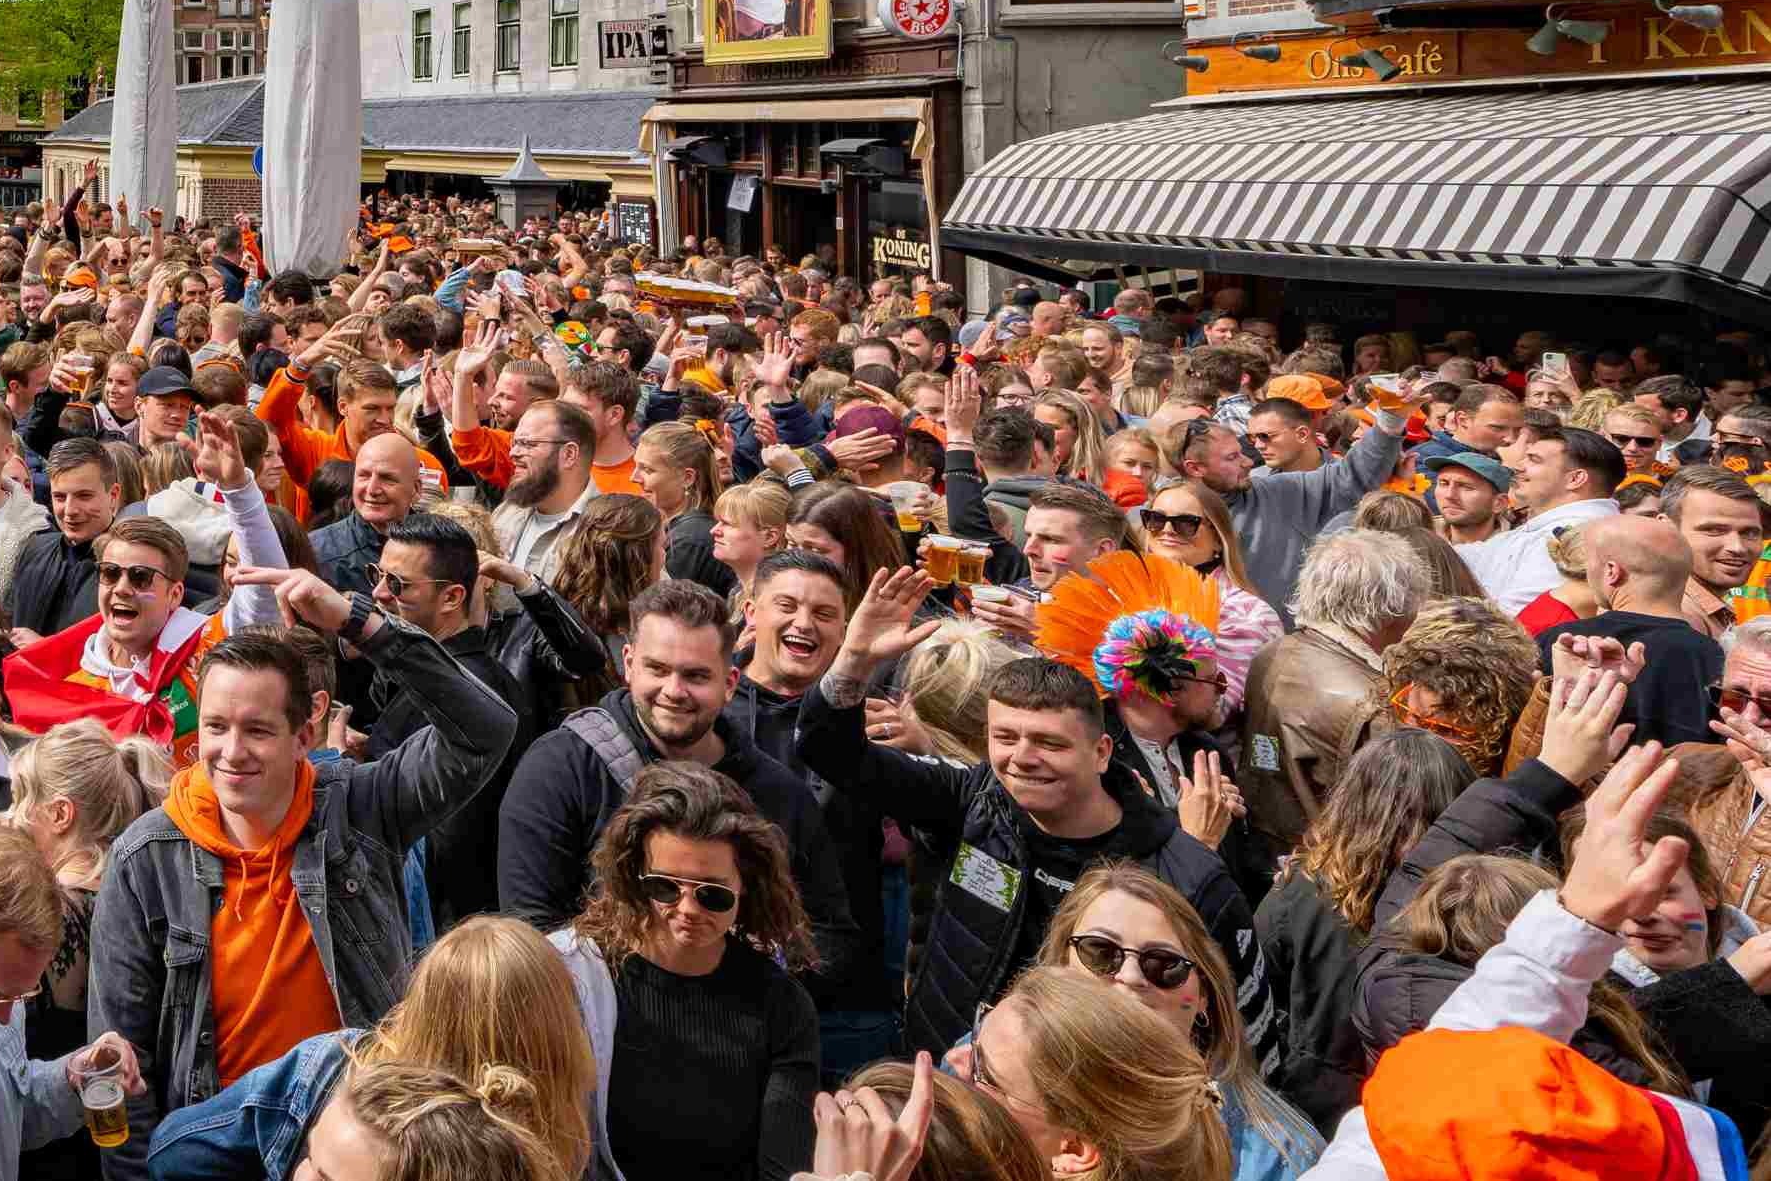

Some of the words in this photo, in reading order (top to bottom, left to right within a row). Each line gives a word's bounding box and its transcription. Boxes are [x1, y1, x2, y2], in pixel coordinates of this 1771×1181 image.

[911, 18, 940, 35] Bier
[604, 31, 648, 59] IPA
[896, 229, 907, 240] DE
[873, 236, 931, 269] KONING
